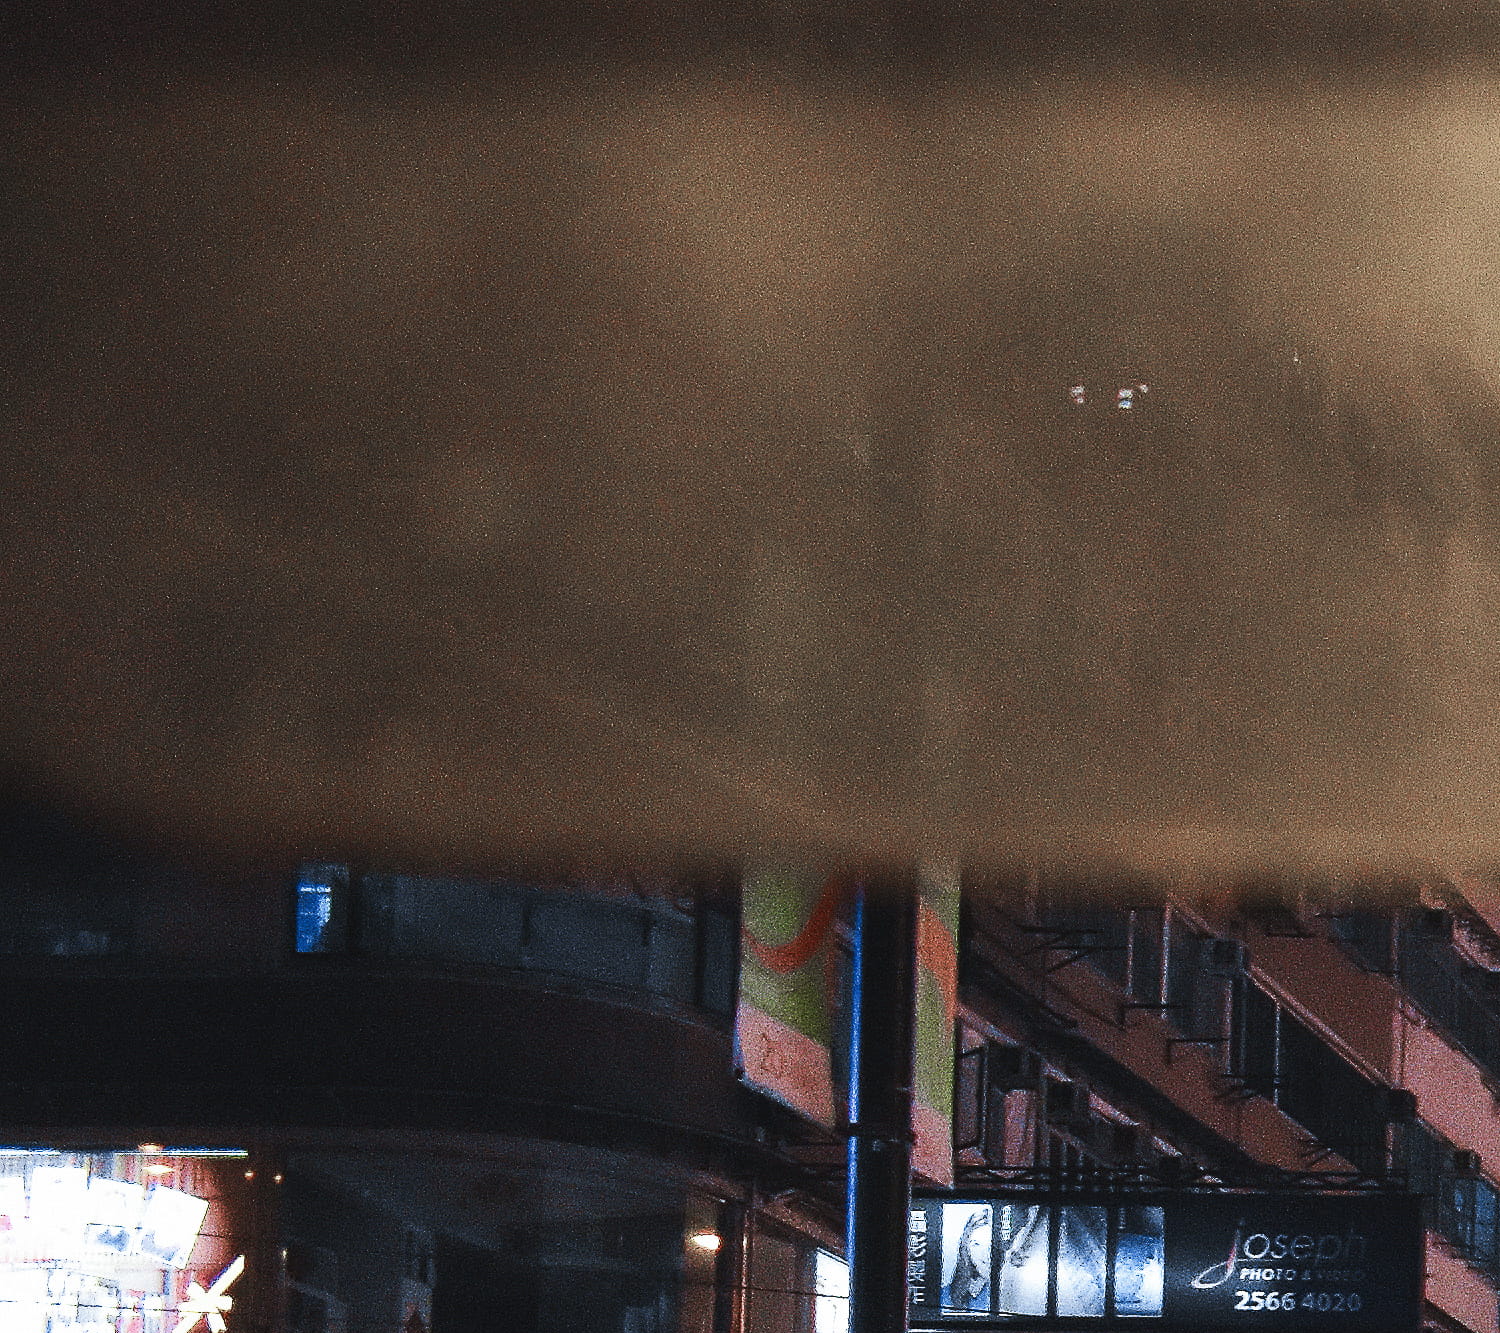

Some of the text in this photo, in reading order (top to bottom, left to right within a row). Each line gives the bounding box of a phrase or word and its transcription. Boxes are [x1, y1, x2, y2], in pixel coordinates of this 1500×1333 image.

[1239, 1267, 1296, 1281] PHOTO
[1234, 1290, 1362, 1312] 2566 4020
